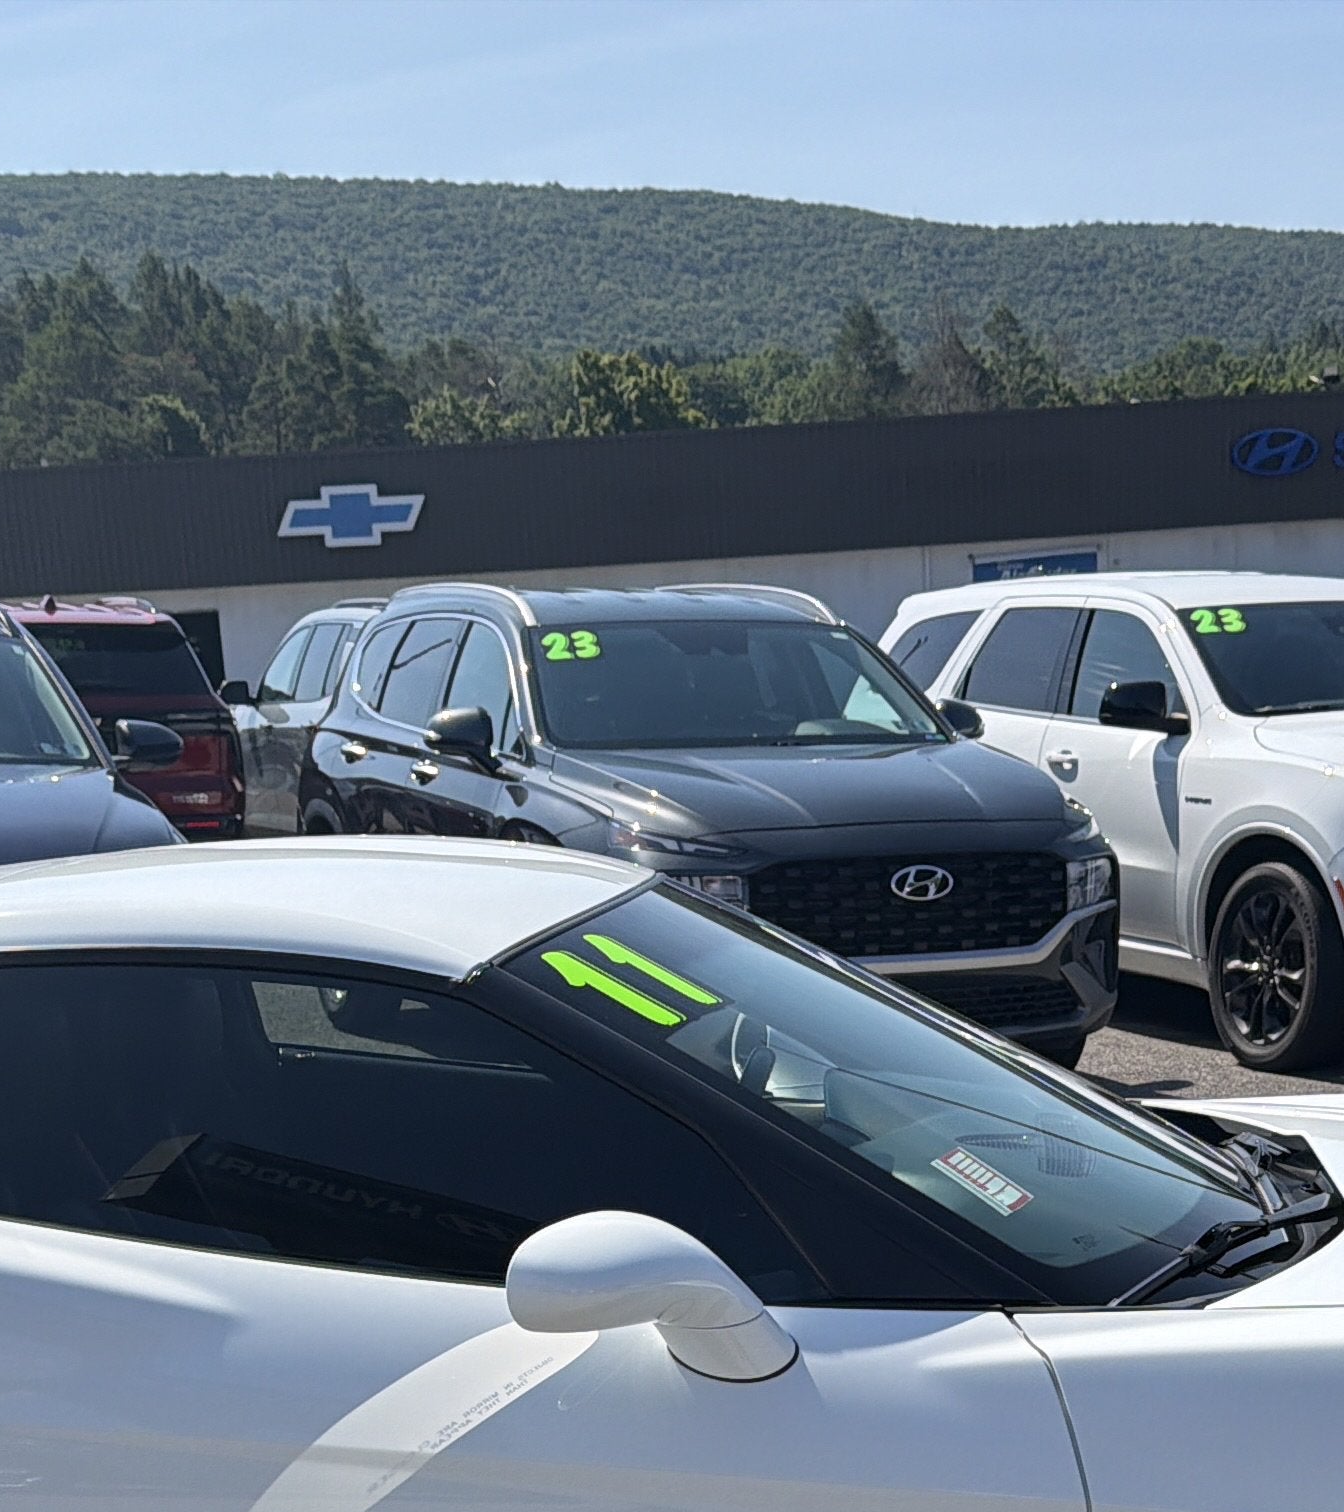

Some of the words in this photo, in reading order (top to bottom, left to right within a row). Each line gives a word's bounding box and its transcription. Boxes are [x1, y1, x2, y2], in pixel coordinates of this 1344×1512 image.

[1190, 607, 1246, 634] 23
[541, 630, 601, 661] 23
[540, 933, 720, 1028] 11
